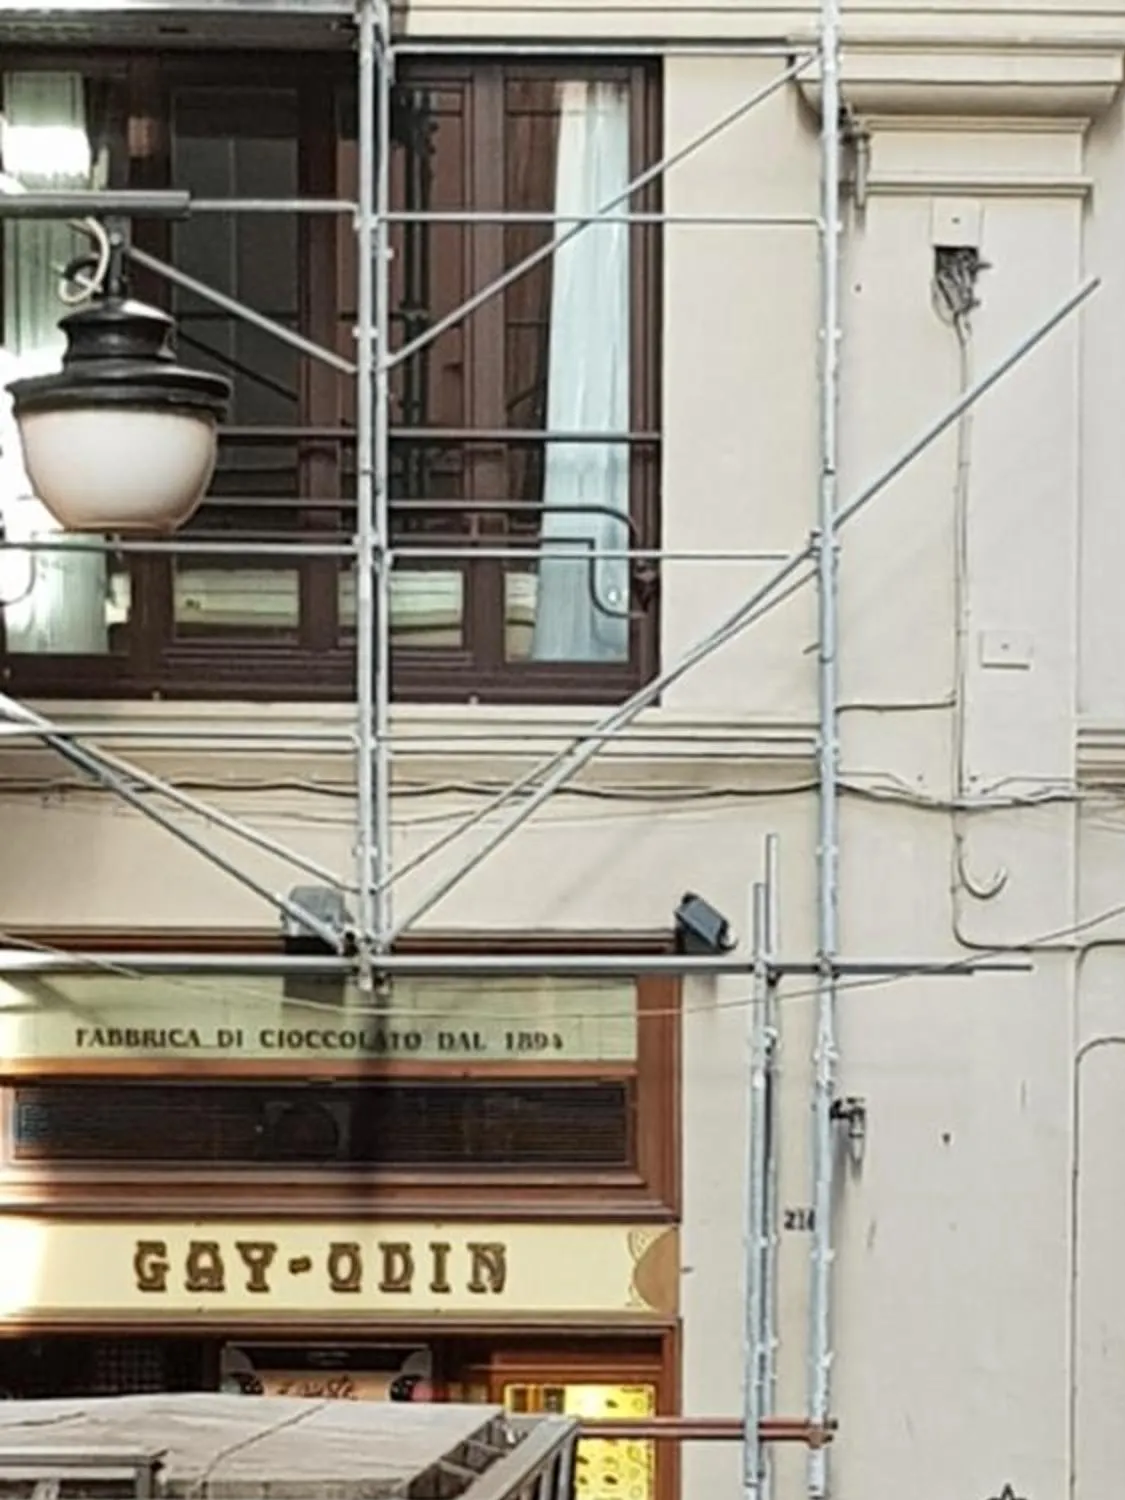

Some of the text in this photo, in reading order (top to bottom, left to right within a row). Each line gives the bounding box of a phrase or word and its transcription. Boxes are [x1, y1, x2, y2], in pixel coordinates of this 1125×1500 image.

[75, 1028, 200, 1048] FABBRICA
[217, 1029, 243, 1048] DI
[259, 1029, 422, 1050] CIOCCOLATO
[438, 1031, 487, 1051] DAL
